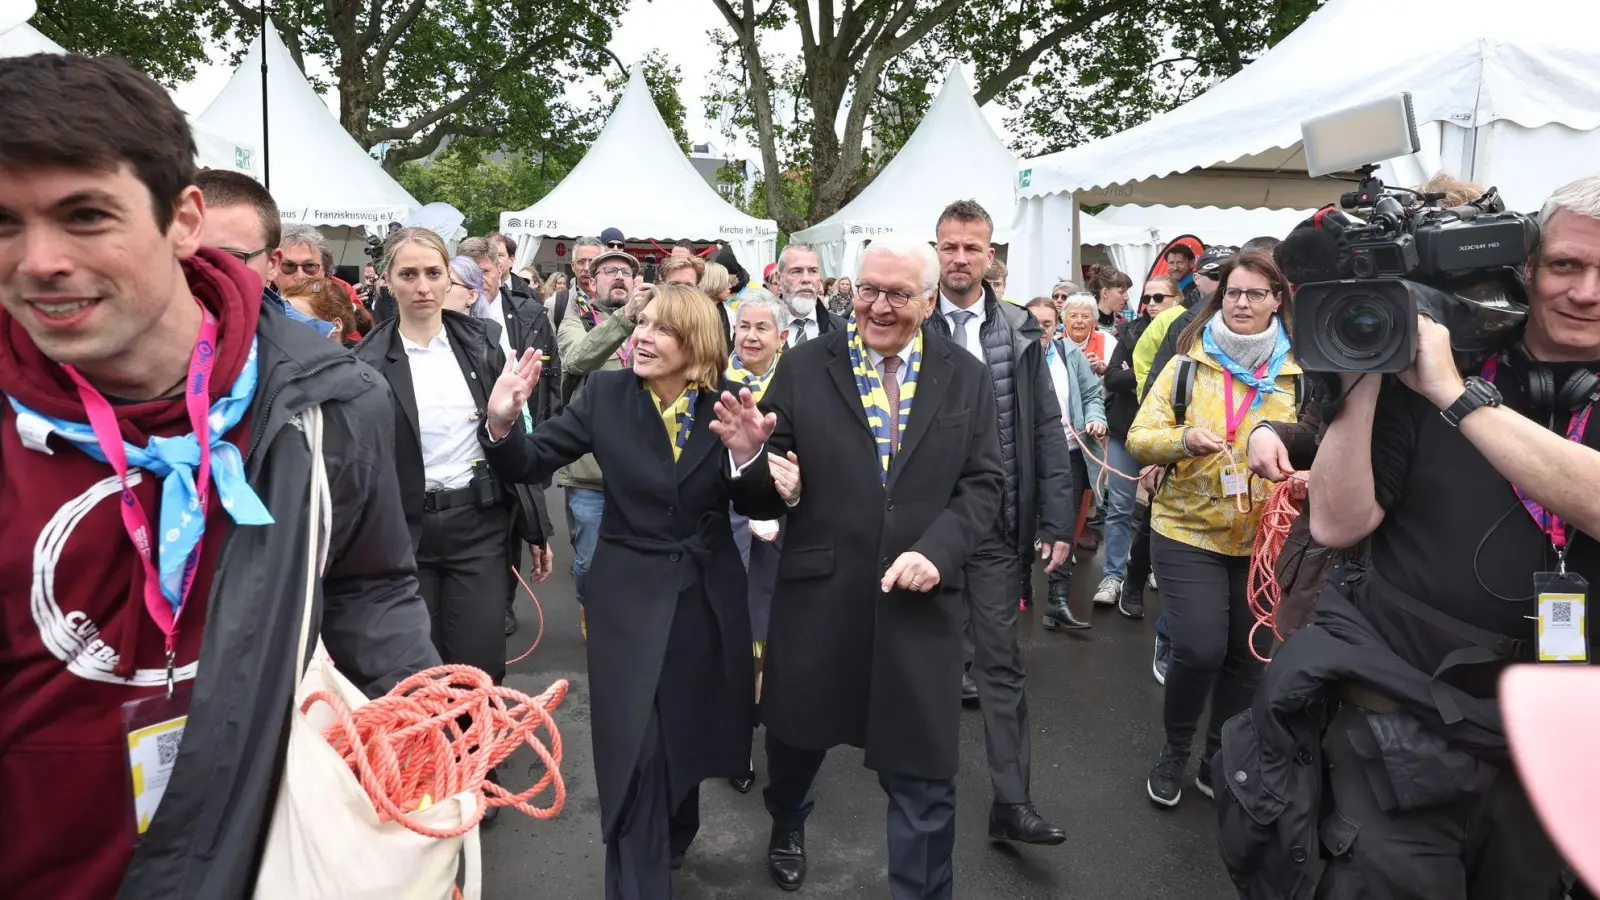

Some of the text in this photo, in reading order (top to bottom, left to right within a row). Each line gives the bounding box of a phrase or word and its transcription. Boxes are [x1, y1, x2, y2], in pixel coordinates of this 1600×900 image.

[280, 210, 297, 219] aus
[314, 209, 378, 222] Franziskusweg
[380, 211, 397, 220] e.V.
[524, 219, 557, 229] FB-F-23
[719, 225, 744, 234] Kirche
[745, 226, 753, 235] in
[1459, 243, 1486, 251] XDCAM
